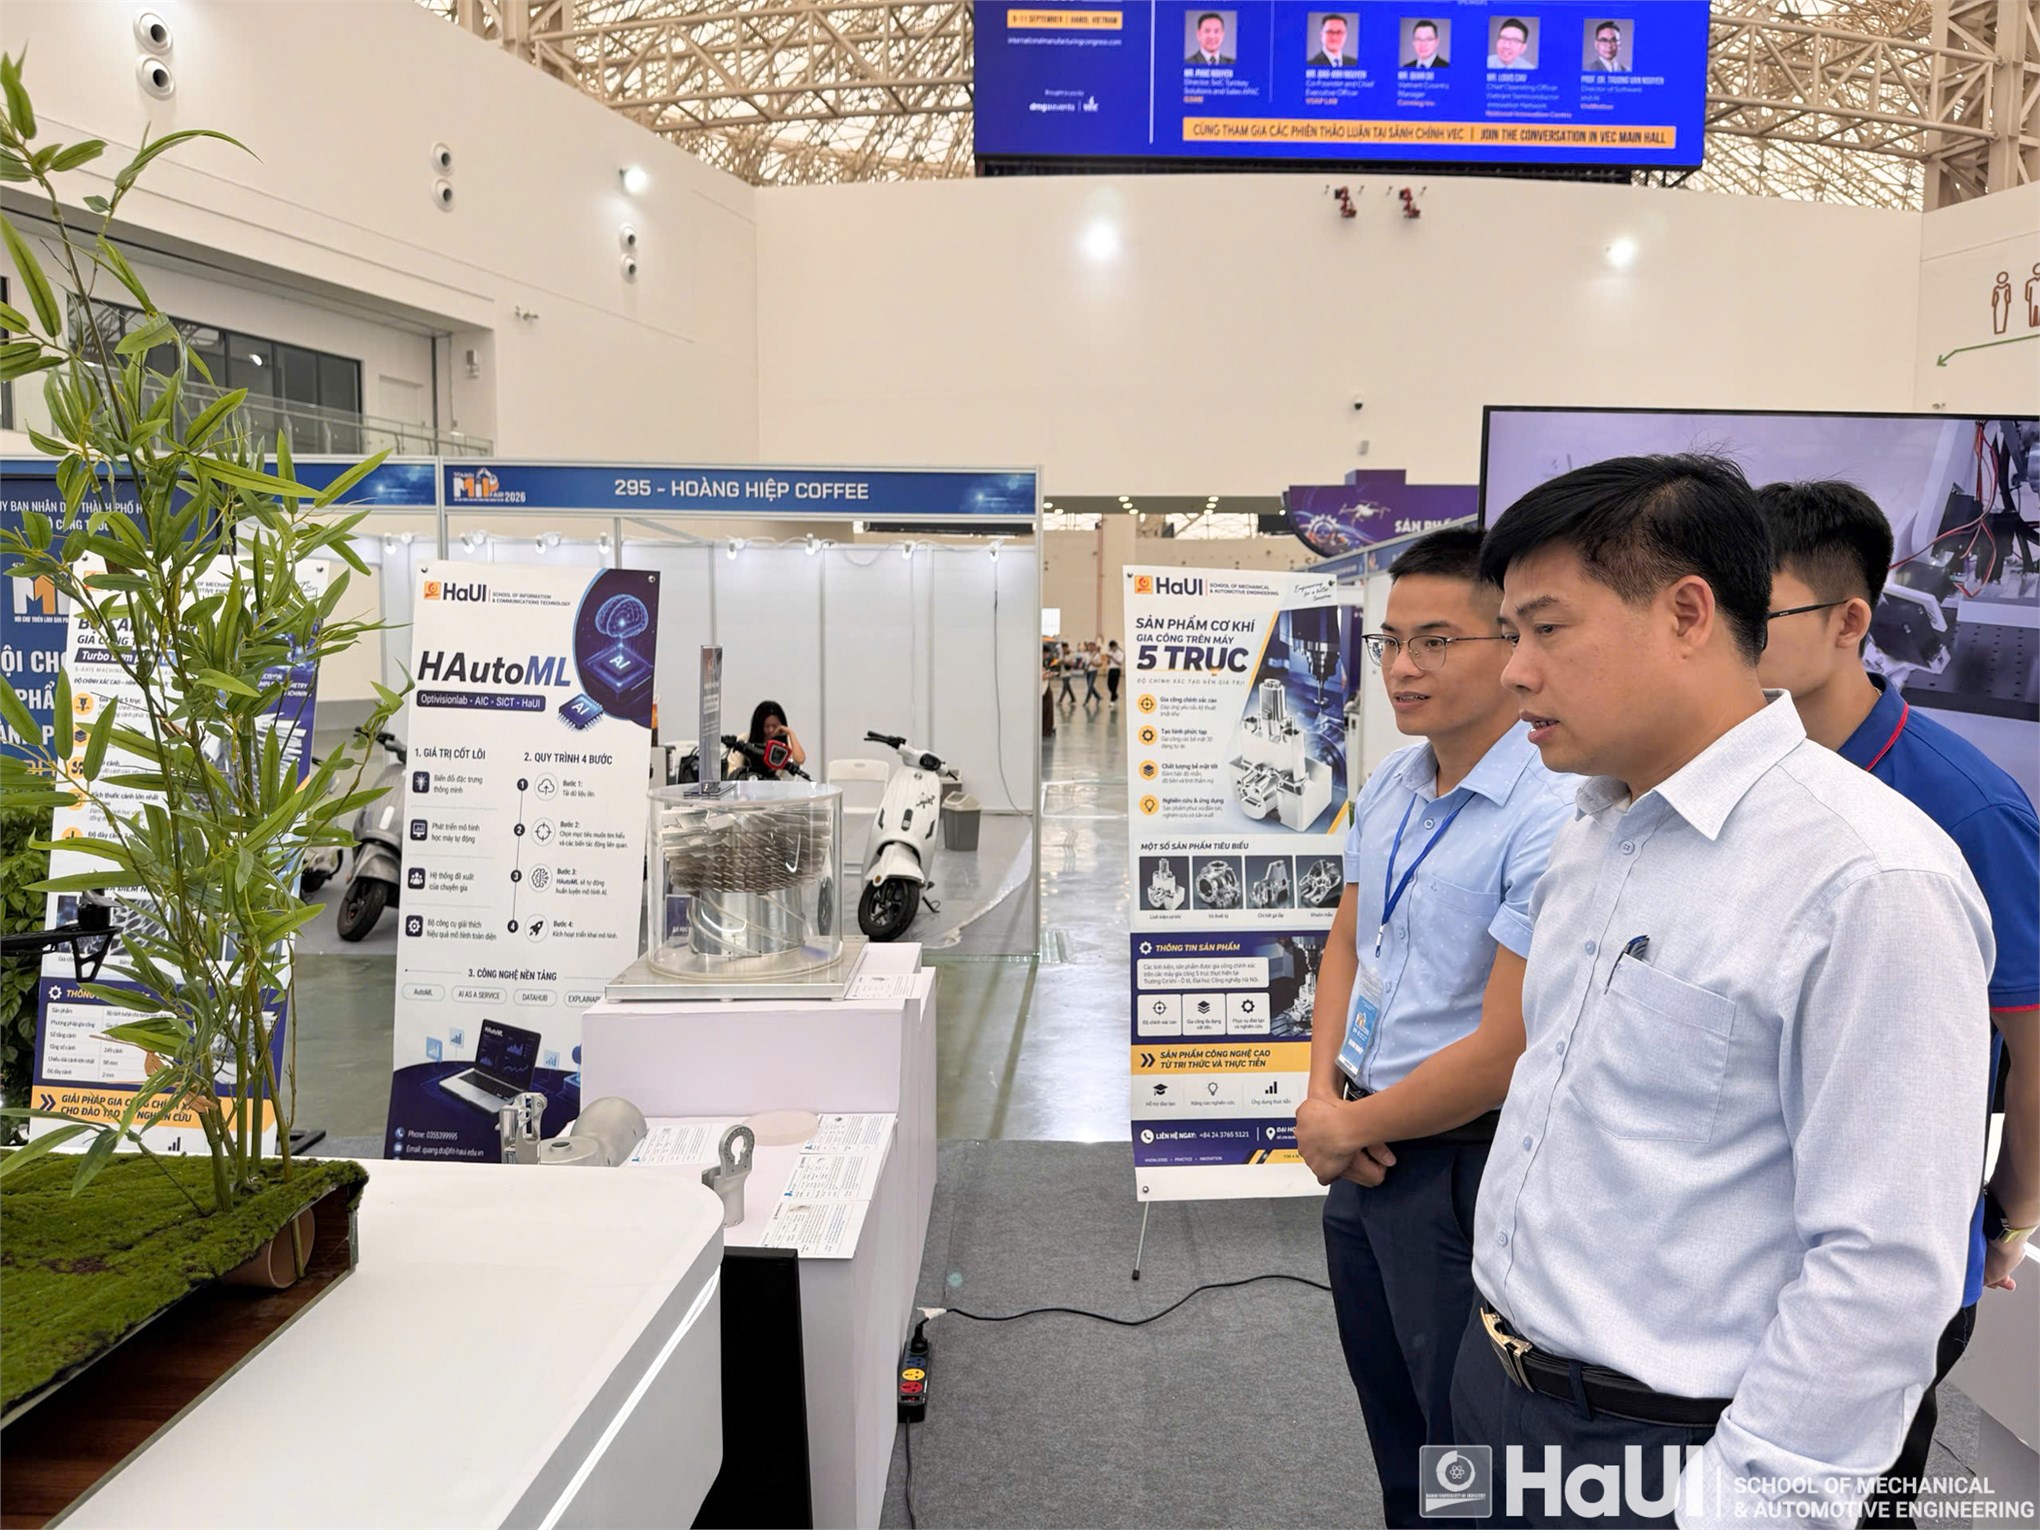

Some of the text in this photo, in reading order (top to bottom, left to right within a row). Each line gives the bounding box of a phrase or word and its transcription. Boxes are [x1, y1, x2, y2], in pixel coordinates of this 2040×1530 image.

[1222, 124, 1248, 136] THAM
[1251, 124, 1267, 136] GIA
[1480, 128, 1666, 144] JOIN THE CONVERSATION IN VEC MAIN HALL
[615, 480, 651, 496] 295
[671, 477, 740, 498] HOÀNG
[745, 479, 790, 502] HIỆP
[795, 481, 869, 500] COFFEE
[505, 491, 526, 503] 2026
[11, 501, 29, 512] BAN
[32, 499, 57, 512] NHÂN
[114, 500, 133, 513] PHỐ
[1395, 518, 1422, 533] SẢN
[443, 582, 487, 602] HaUI
[1156, 578, 1203, 596] HaUI
[1136, 613, 1257, 633] SẢN PHẨM CƠ KHÍ
[1136, 632, 1235, 644] GIA CÔNG TRÊN MÁY
[82, 651, 110, 661] Turbo
[609, 654, 630, 670] AI
[1137, 645, 1249, 677] 5 TRỤC
[418, 651, 571, 687] HAutoML
[421, 694, 541, 708] Optivisionlab AIC SICT HaUI
[571, 701, 588, 716] AI
[415, 748, 422, 757] 1.
[424, 748, 438, 758] GIÁ
[439, 749, 452, 760] TRỊ
[453, 747, 470, 759] CỐT
[524, 752, 613, 765] 2. QUY TRÌNH 4 BƯỚC
[1141, 840, 1249, 851] MỘT SỐ SẢN PHẨM TIÊU BIỂU
[1156, 941, 1241, 952] THÔNG TIN SẢN PHẨM
[469, 968, 557, 981] 3. CÔNG NGHỆ NỀN TẢNG
[479, 992, 500, 1000] SERVICE
[522, 994, 548, 1002] DATAHUB
[1160, 1049, 1271, 1059] SẢN PHẨM CÔNG NGHỆ CAO
[1188, 1060, 1210, 1068] THỨC
[1225, 1061, 1247, 1069] THỰC
[1248, 1058, 1266, 1067] TIỄN
[62, 1093, 123, 1106] GIẢI PHÁP GIA
[61, 1106, 79, 1115] CHO
[81, 1105, 100, 1116] ĐÀO
[1156, 1131, 1170, 1140] LIÊN
